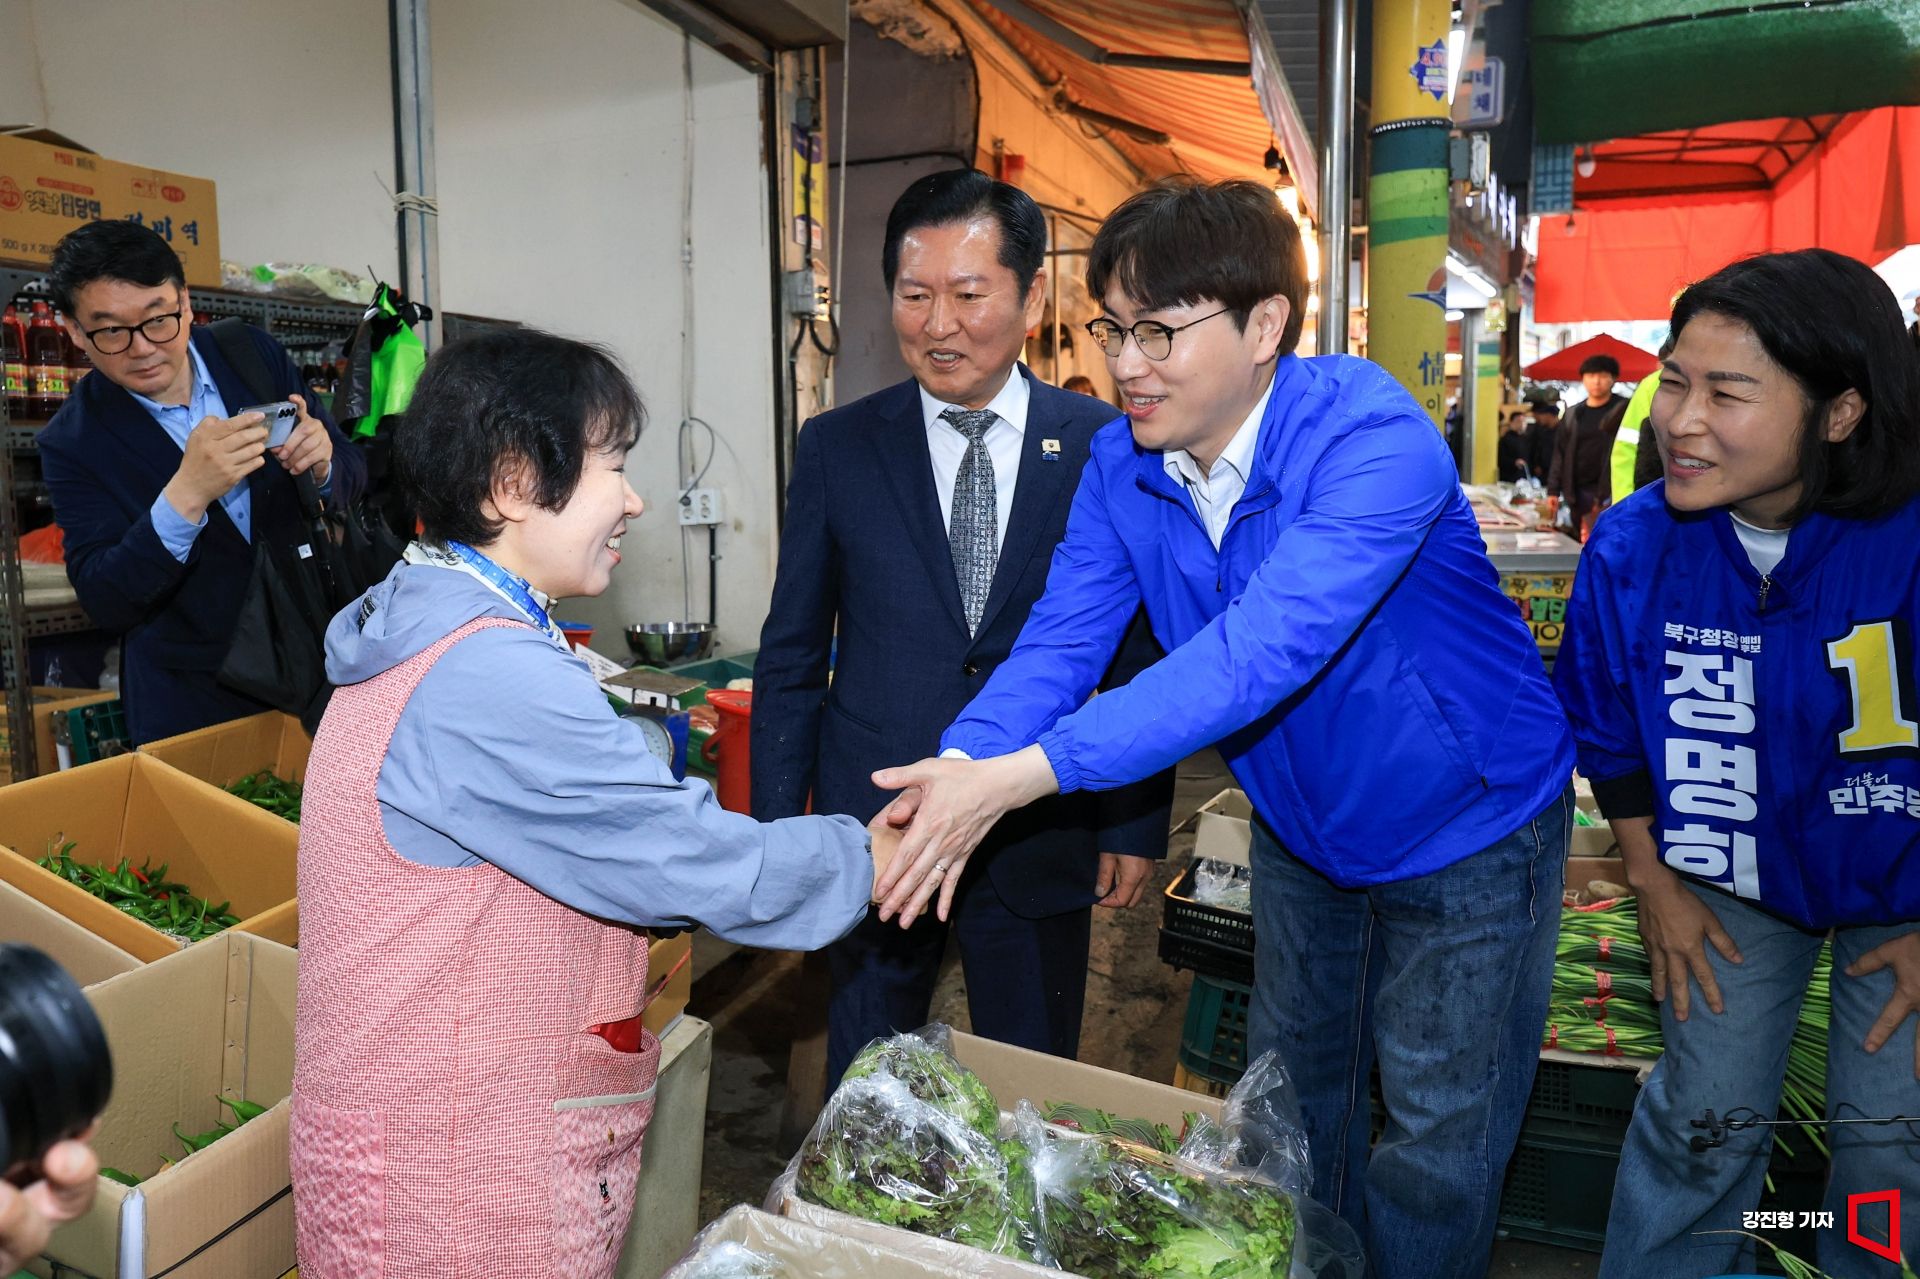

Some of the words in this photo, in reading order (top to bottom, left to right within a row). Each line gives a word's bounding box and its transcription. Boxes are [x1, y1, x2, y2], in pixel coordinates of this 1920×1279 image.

[1664, 621, 1739, 650] 북구청장
[1826, 620, 1919, 754] 1
[1843, 771, 1889, 788] 더불어
